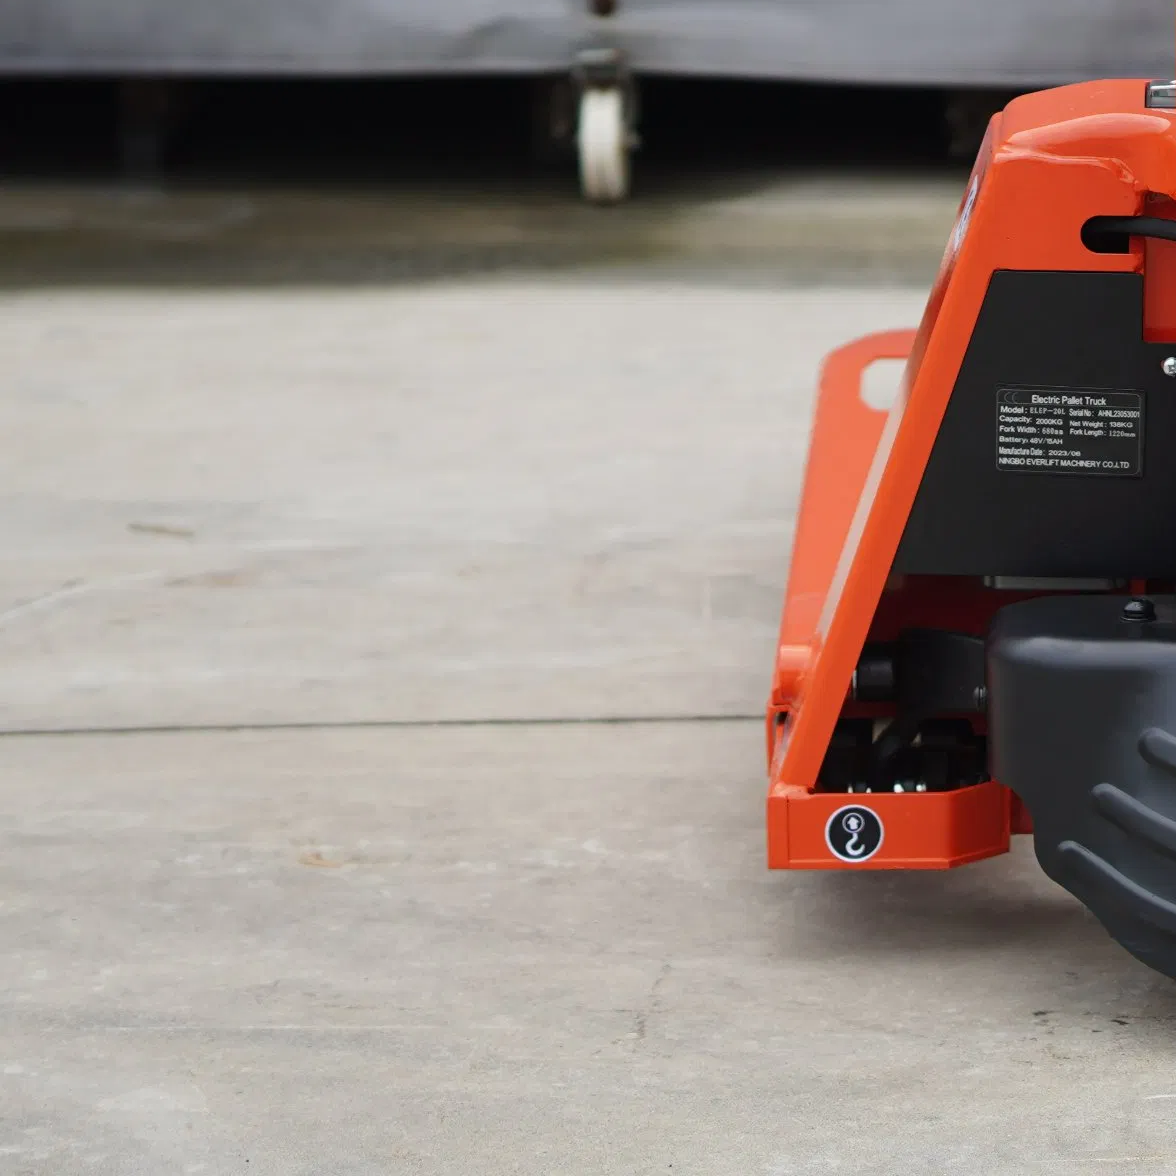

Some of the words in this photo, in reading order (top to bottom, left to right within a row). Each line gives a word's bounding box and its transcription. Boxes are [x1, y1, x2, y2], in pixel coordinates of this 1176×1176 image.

[1031, 394, 1061, 404] Electric
[1061, 395, 1083, 405] Pallet
[1084, 396, 1107, 406] Truck
[1068, 408, 1084, 417] Serial
[999, 425, 1016, 433] Fork
[1041, 427, 1064, 435] 680mm
[1109, 430, 1136, 438] 1220mm
[998, 446, 1030, 456] Manufacture
[998, 456, 1026, 465] NINGBO
[1026, 457, 1060, 466] EVERLIFT
[1060, 459, 1101, 468] MACHINERY
